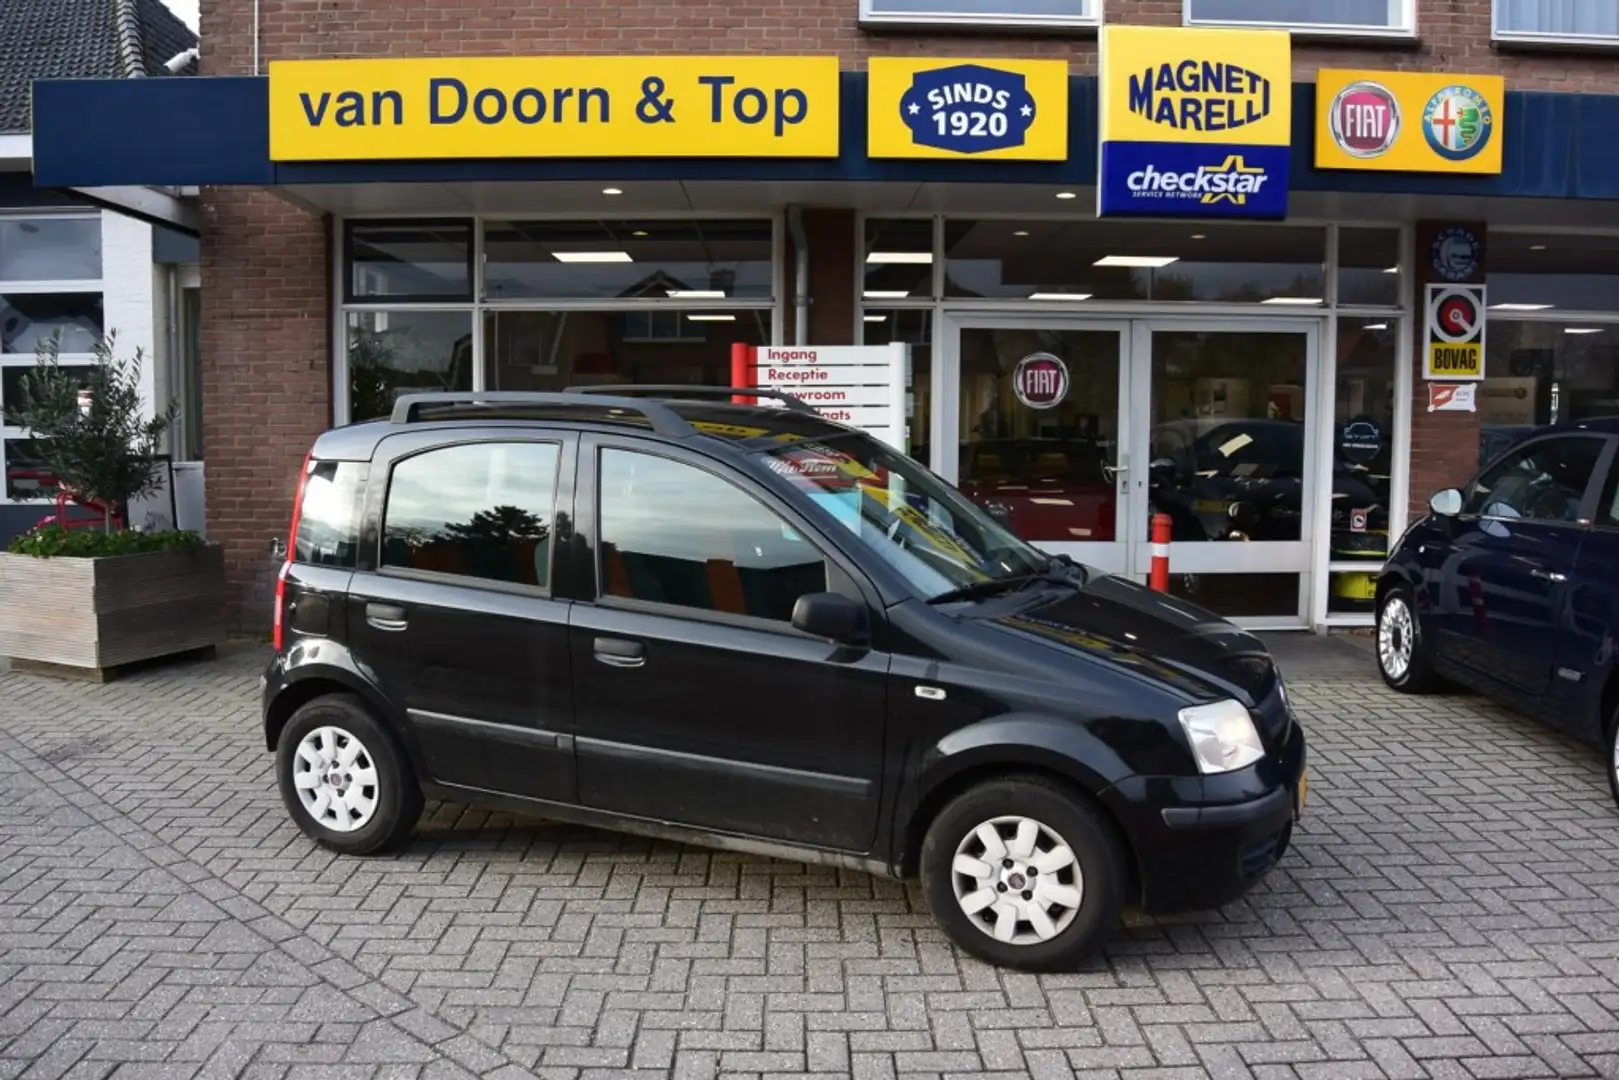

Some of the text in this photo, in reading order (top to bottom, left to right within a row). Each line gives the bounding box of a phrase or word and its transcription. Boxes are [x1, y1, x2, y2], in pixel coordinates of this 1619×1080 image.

[927, 82, 1011, 110] SINDS
[1129, 60, 1271, 110] MAGNETI
[299, 75, 808, 137] van Doorn & Top
[1129, 82, 1271, 131] MARELLI
[1454, 86, 1492, 125] ROMEO
[932, 111, 1008, 136] 1920
[1345, 104, 1387, 138] FIAT
[1127, 164, 1268, 193] checkstar
[767, 348, 818, 363] Ingang
[1434, 347, 1477, 370] BOVAG
[767, 367, 829, 384] Receptie
[1026, 369, 1058, 395] FIAT
[771, 387, 846, 401] owroom
